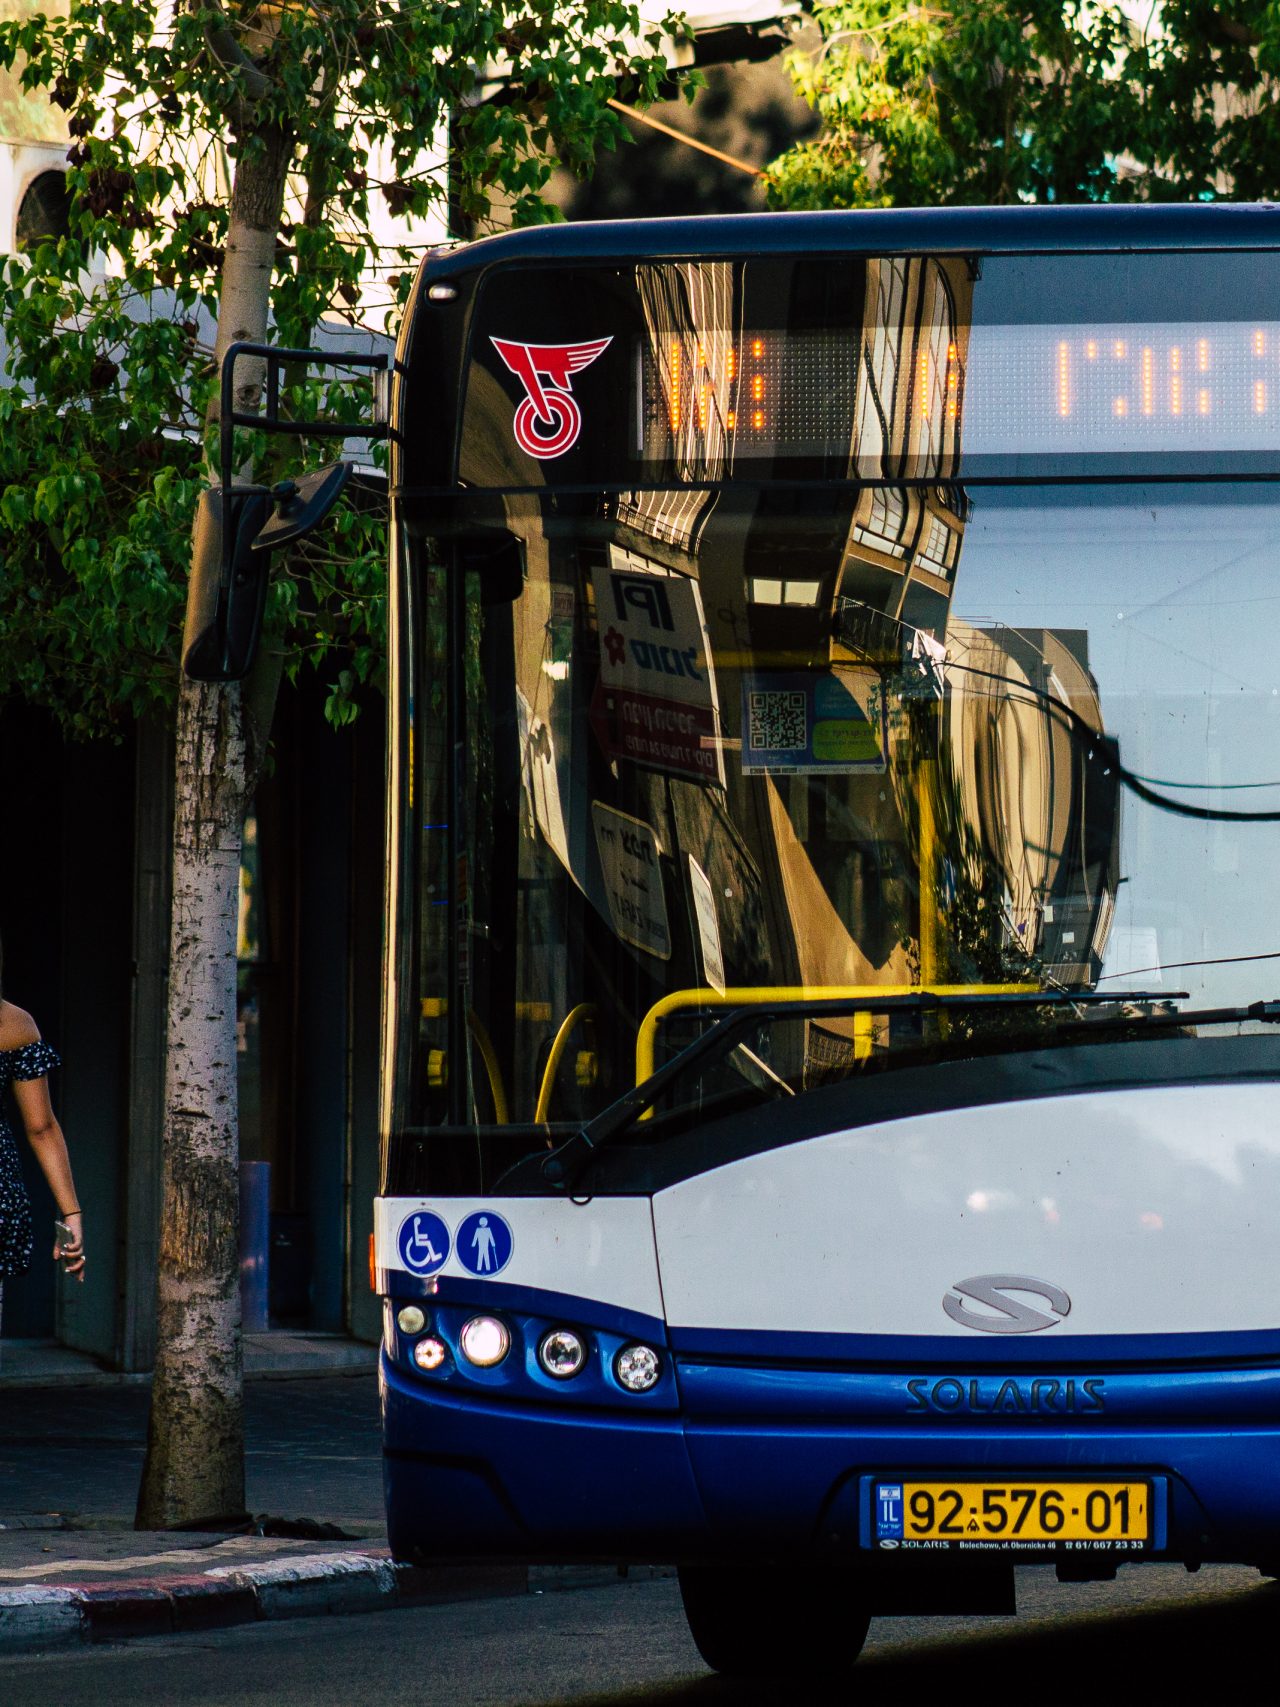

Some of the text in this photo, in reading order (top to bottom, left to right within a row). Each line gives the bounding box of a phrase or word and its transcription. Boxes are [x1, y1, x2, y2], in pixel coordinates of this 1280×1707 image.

[906, 1377, 1106, 1414] SOLARIS
[883, 1501, 899, 1522] IL
[901, 1540, 950, 1549] SOLARIS
